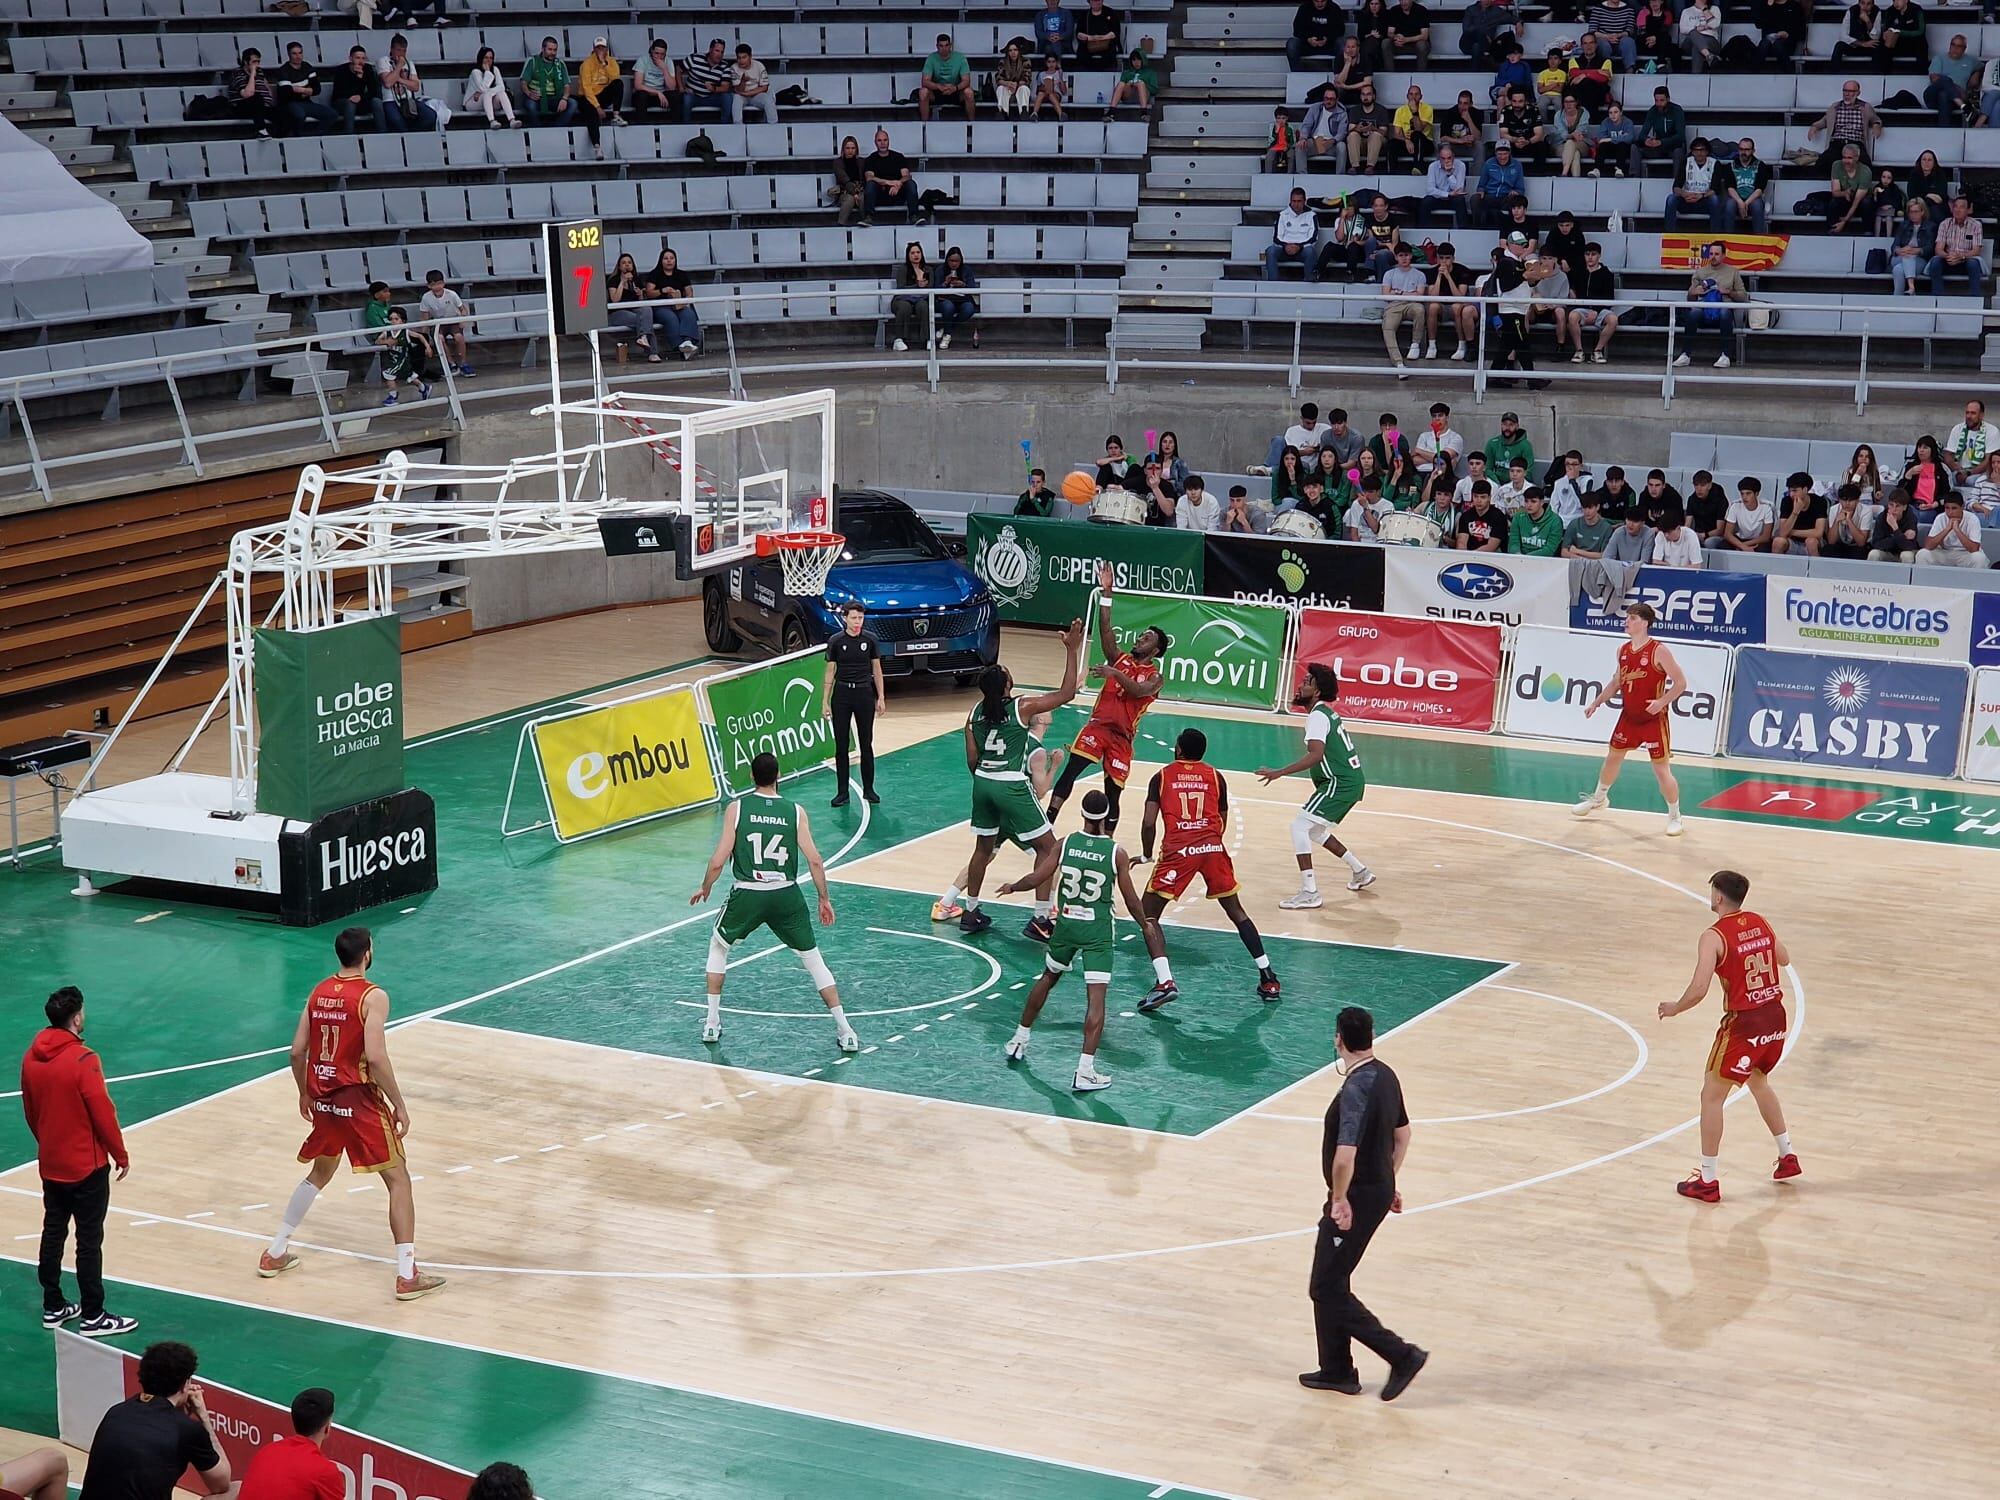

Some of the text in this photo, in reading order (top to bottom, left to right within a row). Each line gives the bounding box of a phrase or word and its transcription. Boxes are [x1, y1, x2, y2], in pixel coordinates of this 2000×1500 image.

[568, 227, 599, 249] 3:02
[574, 266, 593, 308] 7
[1833, 585, 1893, 597] MANANTIAL
[1426, 606, 1521, 627] SUBARU
[1785, 588, 1949, 632] Fontecabras
[1338, 625, 1378, 639] GRUPO
[1586, 618, 1627, 627] LIMPIEZ
[1704, 625, 1747, 635] PISCINAS
[1800, 628, 1937, 646] AGUA MINERAL NATURAL
[1333, 657, 1458, 691] Lobe
[1757, 680, 1816, 692] CLIMATIZACIÓN
[316, 682, 393, 716] Lobe
[1345, 696, 1444, 714] HIGH QUALITY HOMES
[1880, 691, 1941, 703] CLIMATIZACIÓN
[726, 708, 774, 735] Grupo
[985, 729, 1006, 755] 4
[1749, 708, 1940, 763] GASBY
[567, 734, 690, 799] embou
[1179, 791, 1205, 820] 17
[1855, 810, 1931, 827] de
[750, 814, 788, 826] BARRAL
[320, 826, 427, 891] Huesca
[746, 832, 789, 866] 14
[1068, 848, 1106, 863] BRACEY
[1188, 843, 1223, 856] Occident
[1061, 865, 1106, 902] 33
[1744, 949, 1776, 990] 24
[312, 1010, 347, 1021] BAUHAUS
[320, 1024, 340, 1062] 11
[207, 1410, 261, 1445] GRUPO
